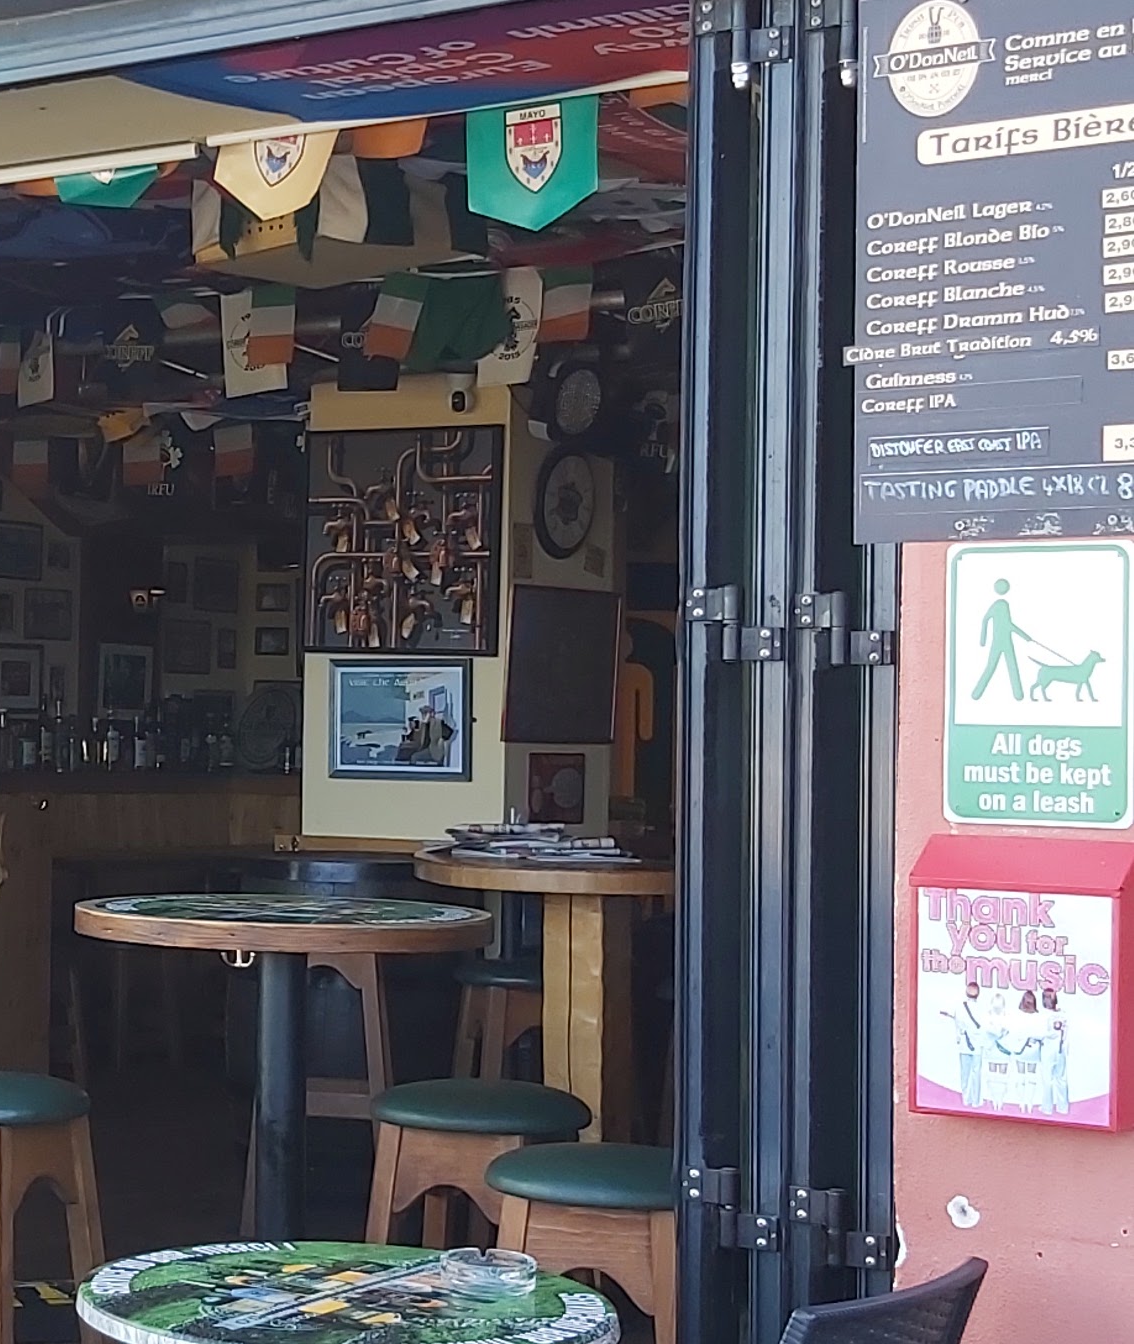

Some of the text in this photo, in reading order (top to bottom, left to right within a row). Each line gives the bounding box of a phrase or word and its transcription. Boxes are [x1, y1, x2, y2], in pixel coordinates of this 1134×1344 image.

[506, 2, 690, 42] aillimh
[1004, 23, 1125, 52] Comme en
[223, 39, 478, 84] of Culture
[307, 52, 514, 87] Capital
[889, 46, 978, 71] O'DonNeil
[1004, 44, 1127, 72] Service au
[301, 60, 552, 103] European
[1005, 68, 1053, 86] merci
[519, 109, 546, 121] MAYO
[929, 124, 1039, 156] Tarifs
[866, 204, 966, 230] O'DonNeil
[971, 200, 1033, 219] Lager
[1108, 214, 1134, 230] 2,8
[866, 236, 939, 256] Coreff
[943, 228, 1014, 249] Blonde
[1018, 224, 1050, 241] Bio
[866, 263, 938, 283] Coreff
[943, 256, 1015, 275] Rousse
[1108, 267, 1134, 281] 2,9
[866, 290, 938, 310] Coreff
[943, 281, 1026, 303] Blanche
[1109, 294, 1134, 308] 2,9
[866, 317, 938, 336] Coreff
[943, 310, 1023, 330] Dramm
[1029, 304, 1071, 322] Hud
[845, 347, 895, 363] Cidre
[900, 341, 942, 357] Brut
[946, 335, 1032, 353] Tradition
[865, 372, 957, 390] Guinness
[861, 393, 957, 414] Coreff IPA
[1015, 431, 1042, 451] IPA
[863, 479, 958, 501] TASTING
[962, 476, 1036, 501] PADDLE
[991, 732, 1083, 761] All dogs
[963, 761, 1112, 790] must be kept
[978, 790, 1095, 814] on a leash
[922, 887, 1056, 928] Thank
[946, 921, 1069, 956] you for
[920, 948, 1110, 996] the music
